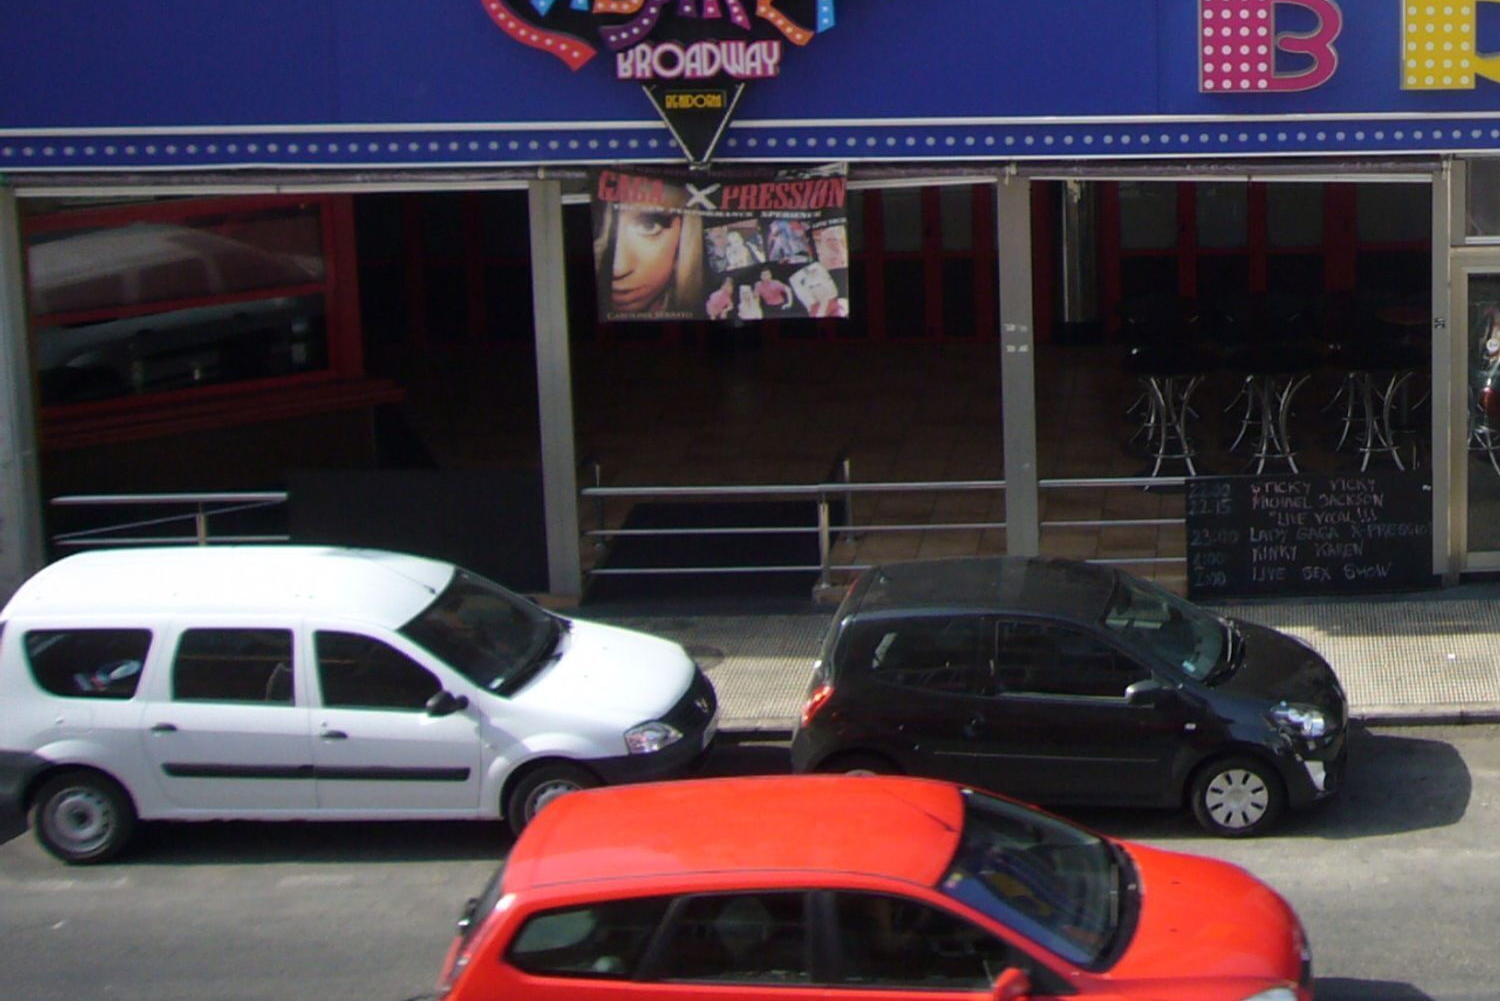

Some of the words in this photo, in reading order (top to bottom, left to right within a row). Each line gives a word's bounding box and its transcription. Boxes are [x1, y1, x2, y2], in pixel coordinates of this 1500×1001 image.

[616, 40, 782, 80] BROADWAY
[597, 169, 665, 204] GAGA
[1329, 477, 1376, 493] VICKY
[1318, 492, 1384, 507] JACKSON
[1295, 524, 1340, 541] GAGA
[1251, 545, 1298, 564] KINKY
[1252, 565, 1287, 582] LIVE
[1301, 565, 1333, 582] SEX
[1342, 561, 1393, 581] SHOW
